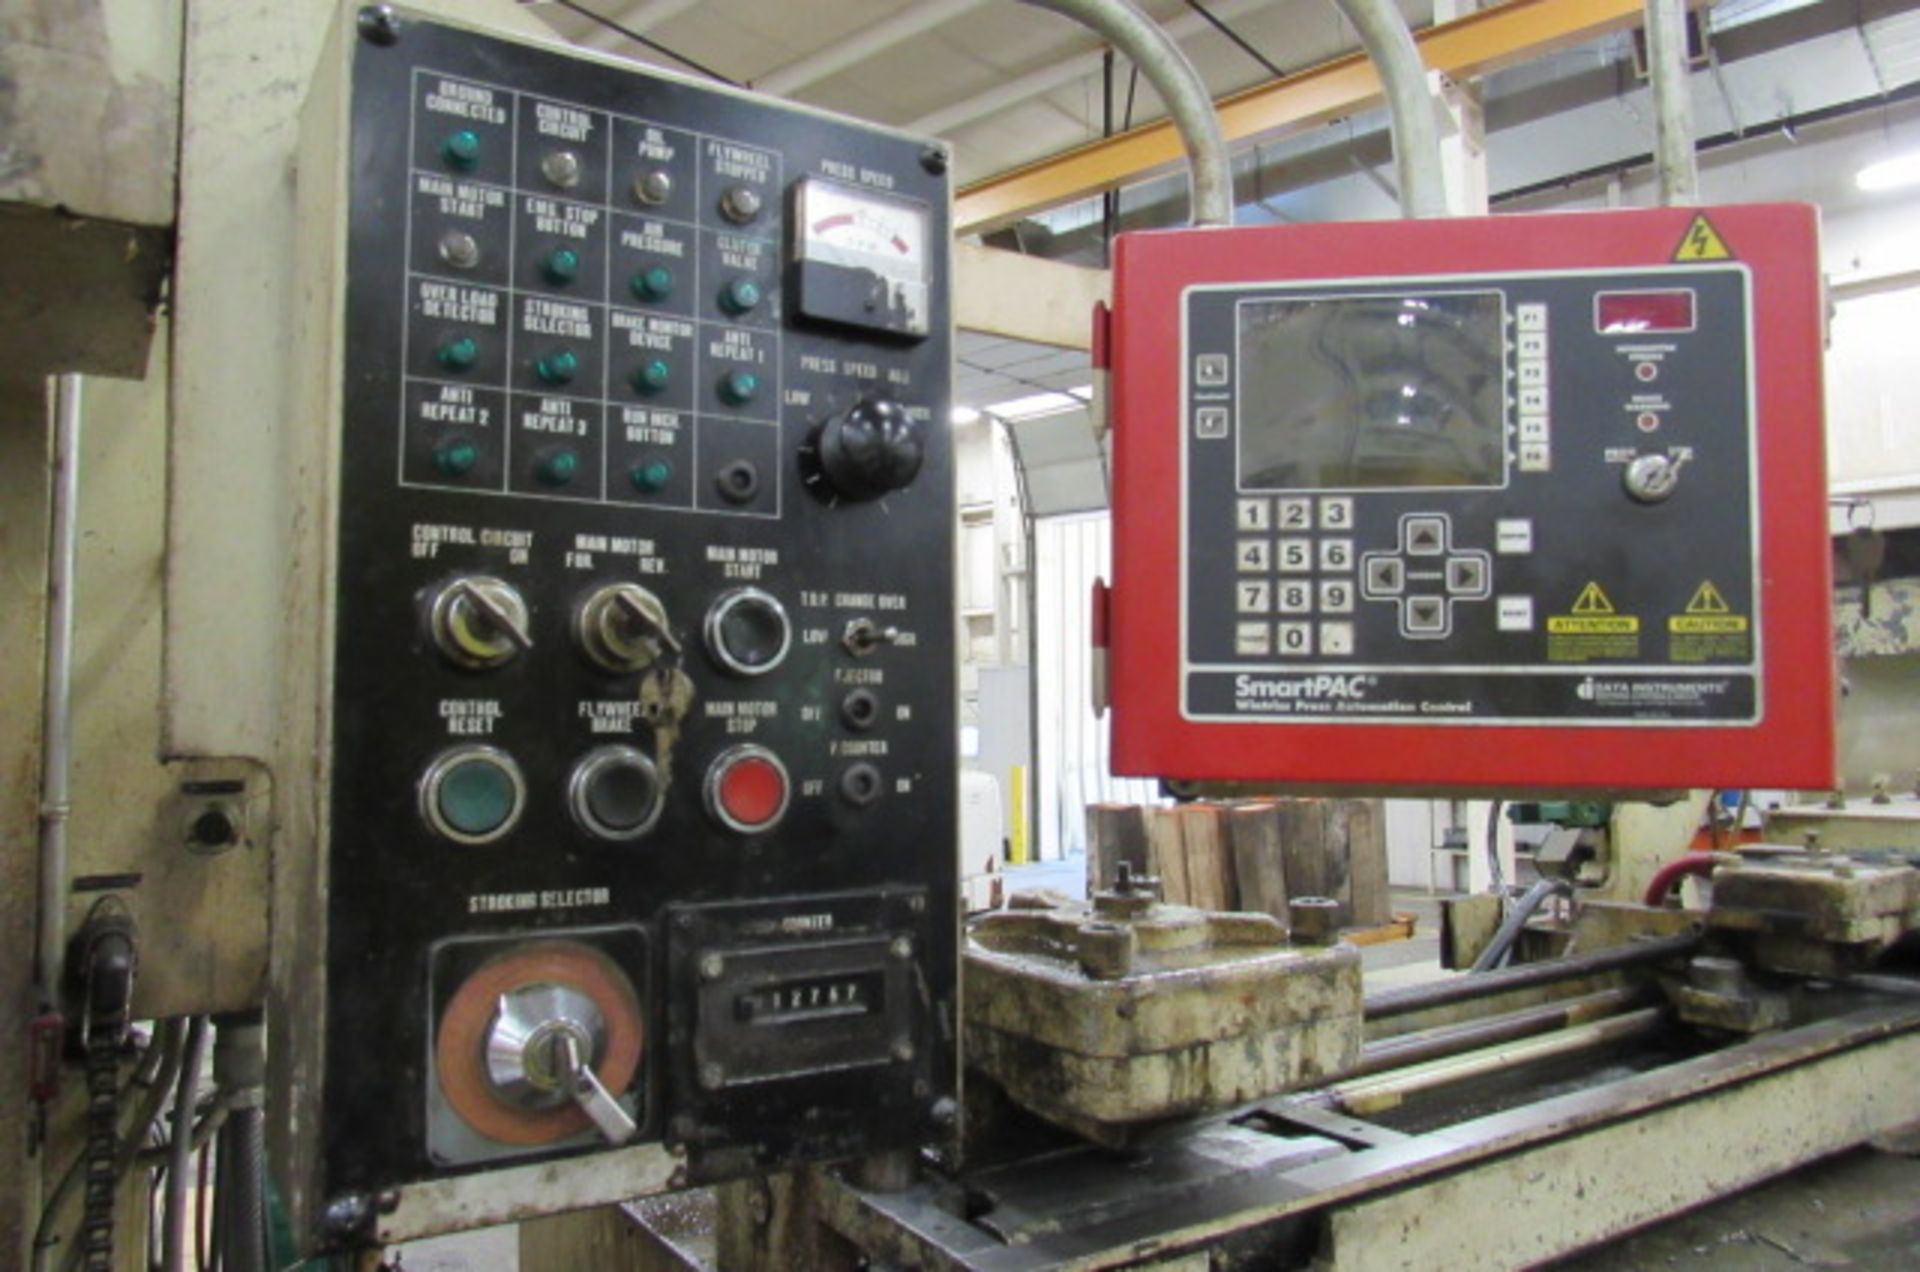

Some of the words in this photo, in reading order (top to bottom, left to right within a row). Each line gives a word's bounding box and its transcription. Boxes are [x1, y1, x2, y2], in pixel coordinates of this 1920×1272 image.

[418, 177, 453, 195] MAIN
[458, 184, 505, 207] MOTOR
[440, 197, 484, 220] START
[566, 206, 599, 225] STOP
[536, 217, 587, 239] BUTTON
[621, 231, 684, 258] PRESSURE
[461, 289, 498, 308] LOAD
[423, 299, 496, 325] DETECTOR
[524, 299, 589, 323] STROKING
[524, 314, 592, 339] SELECTOR
[724, 329, 751, 346] ANTI
[710, 341, 754, 361] REPEAT
[800, 356, 836, 374] PRESS
[843, 362, 877, 379] SPEED
[440, 386, 473, 404] ANTI
[785, 389, 811, 406] LOW
[420, 401, 475, 423] REPEAT
[479, 408, 489, 427] 2
[540, 398, 572, 416] ANTI
[523, 412, 574, 433] REPEAT
[577, 419, 587, 436] 3
[626, 425, 675, 445] BUTTON
[1246, 505, 1258, 524] 1
[1287, 504, 1303, 525] 2
[1328, 503, 1345, 524] 3
[412, 524, 476, 544] CONTROL
[480, 529, 534, 548] CIRCUIT
[575, 533, 607, 552] MAIN
[611, 536, 655, 556] MOTOR
[412, 542, 439, 558] OFF
[509, 548, 529, 565] ON
[706, 545, 736, 561] MAIN
[738, 547, 778, 565] MOTOR
[1244, 546, 1261, 565] 4
[1286, 545, 1303, 565] 5
[1328, 545, 1345, 565] 6
[724, 562, 762, 580] START
[1244, 587, 1261, 607] 7
[1286, 587, 1303, 607] 8
[1328, 587, 1345, 607] 9
[1554, 618, 1632, 631] ATTENTION
[1676, 618, 1739, 631] CAUTION
[803, 629, 829, 643] LOW
[1286, 629, 1303, 649] 0
[439, 699, 503, 718] CONTROL
[705, 700, 736, 717] MAIN
[737, 701, 778, 717] MOTOR
[1295, 700, 1332, 713] Press
[1335, 700, 1416, 713] Automation
[1420, 700, 1472, 713] Control
[448, 716, 494, 734] RESET
[591, 716, 633, 733] BRAKE
[726, 718, 757, 734] STOP
[469, 892, 538, 914] STROKING
[540, 887, 611, 909] SELECTOR
